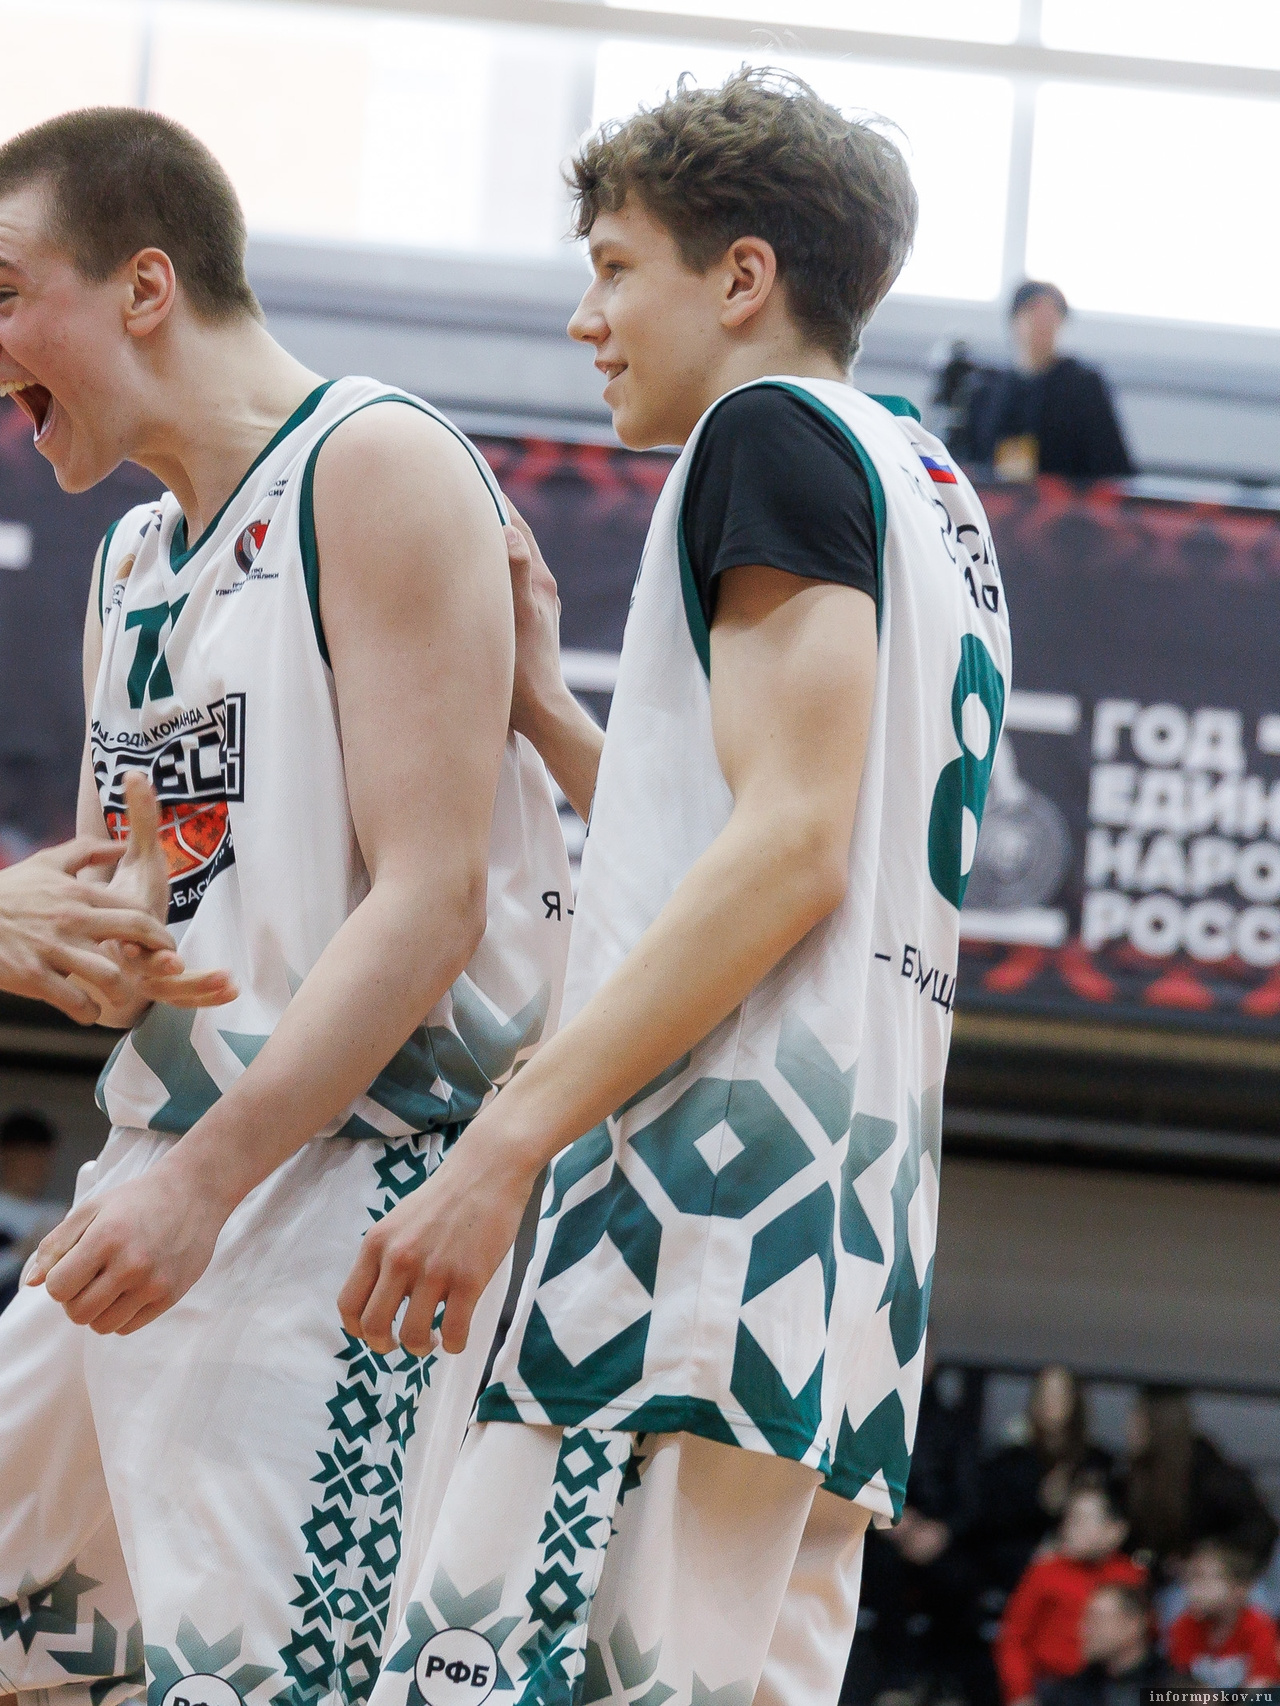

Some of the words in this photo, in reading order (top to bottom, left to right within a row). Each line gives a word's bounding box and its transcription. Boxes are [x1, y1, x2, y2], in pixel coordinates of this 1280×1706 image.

[1090, 698, 1246, 774] ГОД
[928, 633, 1005, 912] 8
[541, 890, 561, 922] Я
[425, 1654, 490, 1688] РФБ
